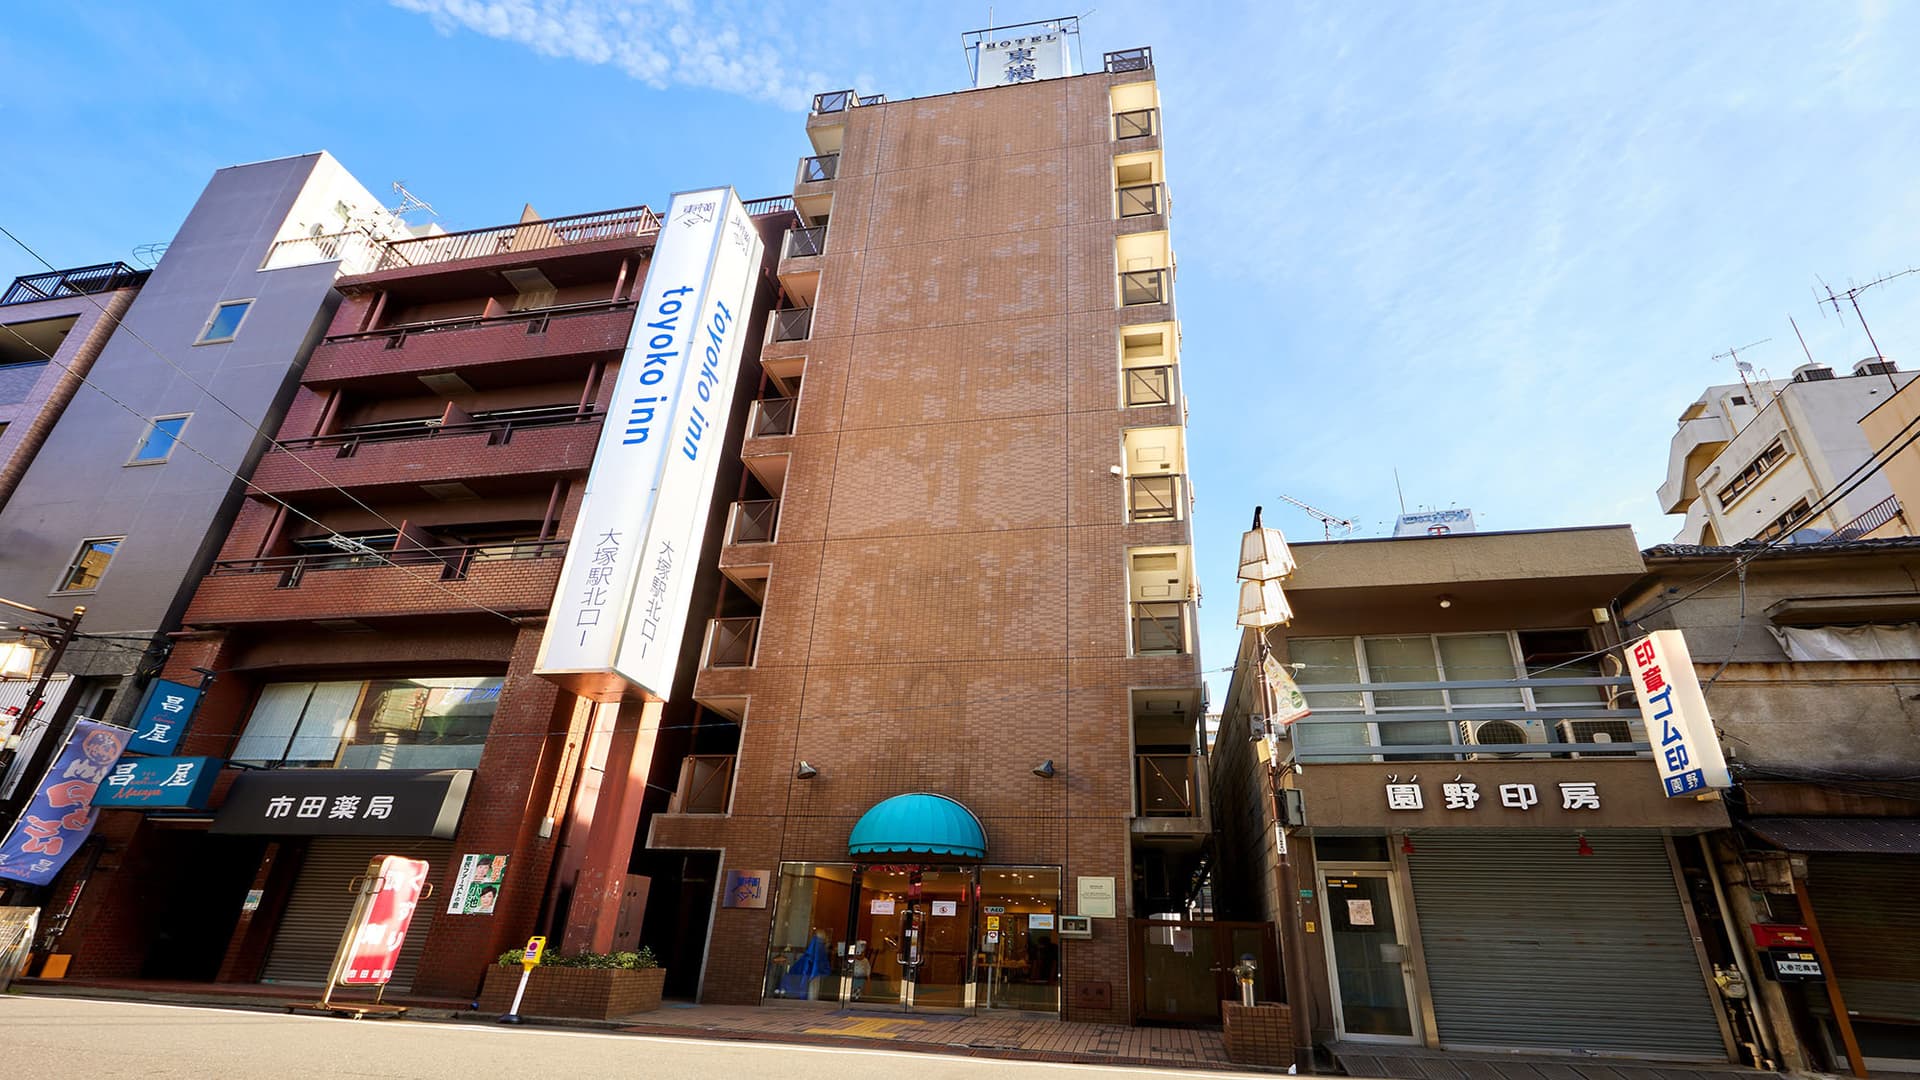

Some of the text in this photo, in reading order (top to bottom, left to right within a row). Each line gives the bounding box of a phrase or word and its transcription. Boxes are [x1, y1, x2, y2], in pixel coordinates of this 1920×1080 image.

[986, 34, 1057, 49] HOTEL
[1003, 47, 1037, 82] 東横
[622, 285, 694, 445] toyoko inn
[682, 300, 732, 461] toyoko inn
[1633, 639, 1690, 773] 印章ゴム印
[264, 795, 395, 819] 市田薬局
[1386, 782, 1600, 810] 園野印房
